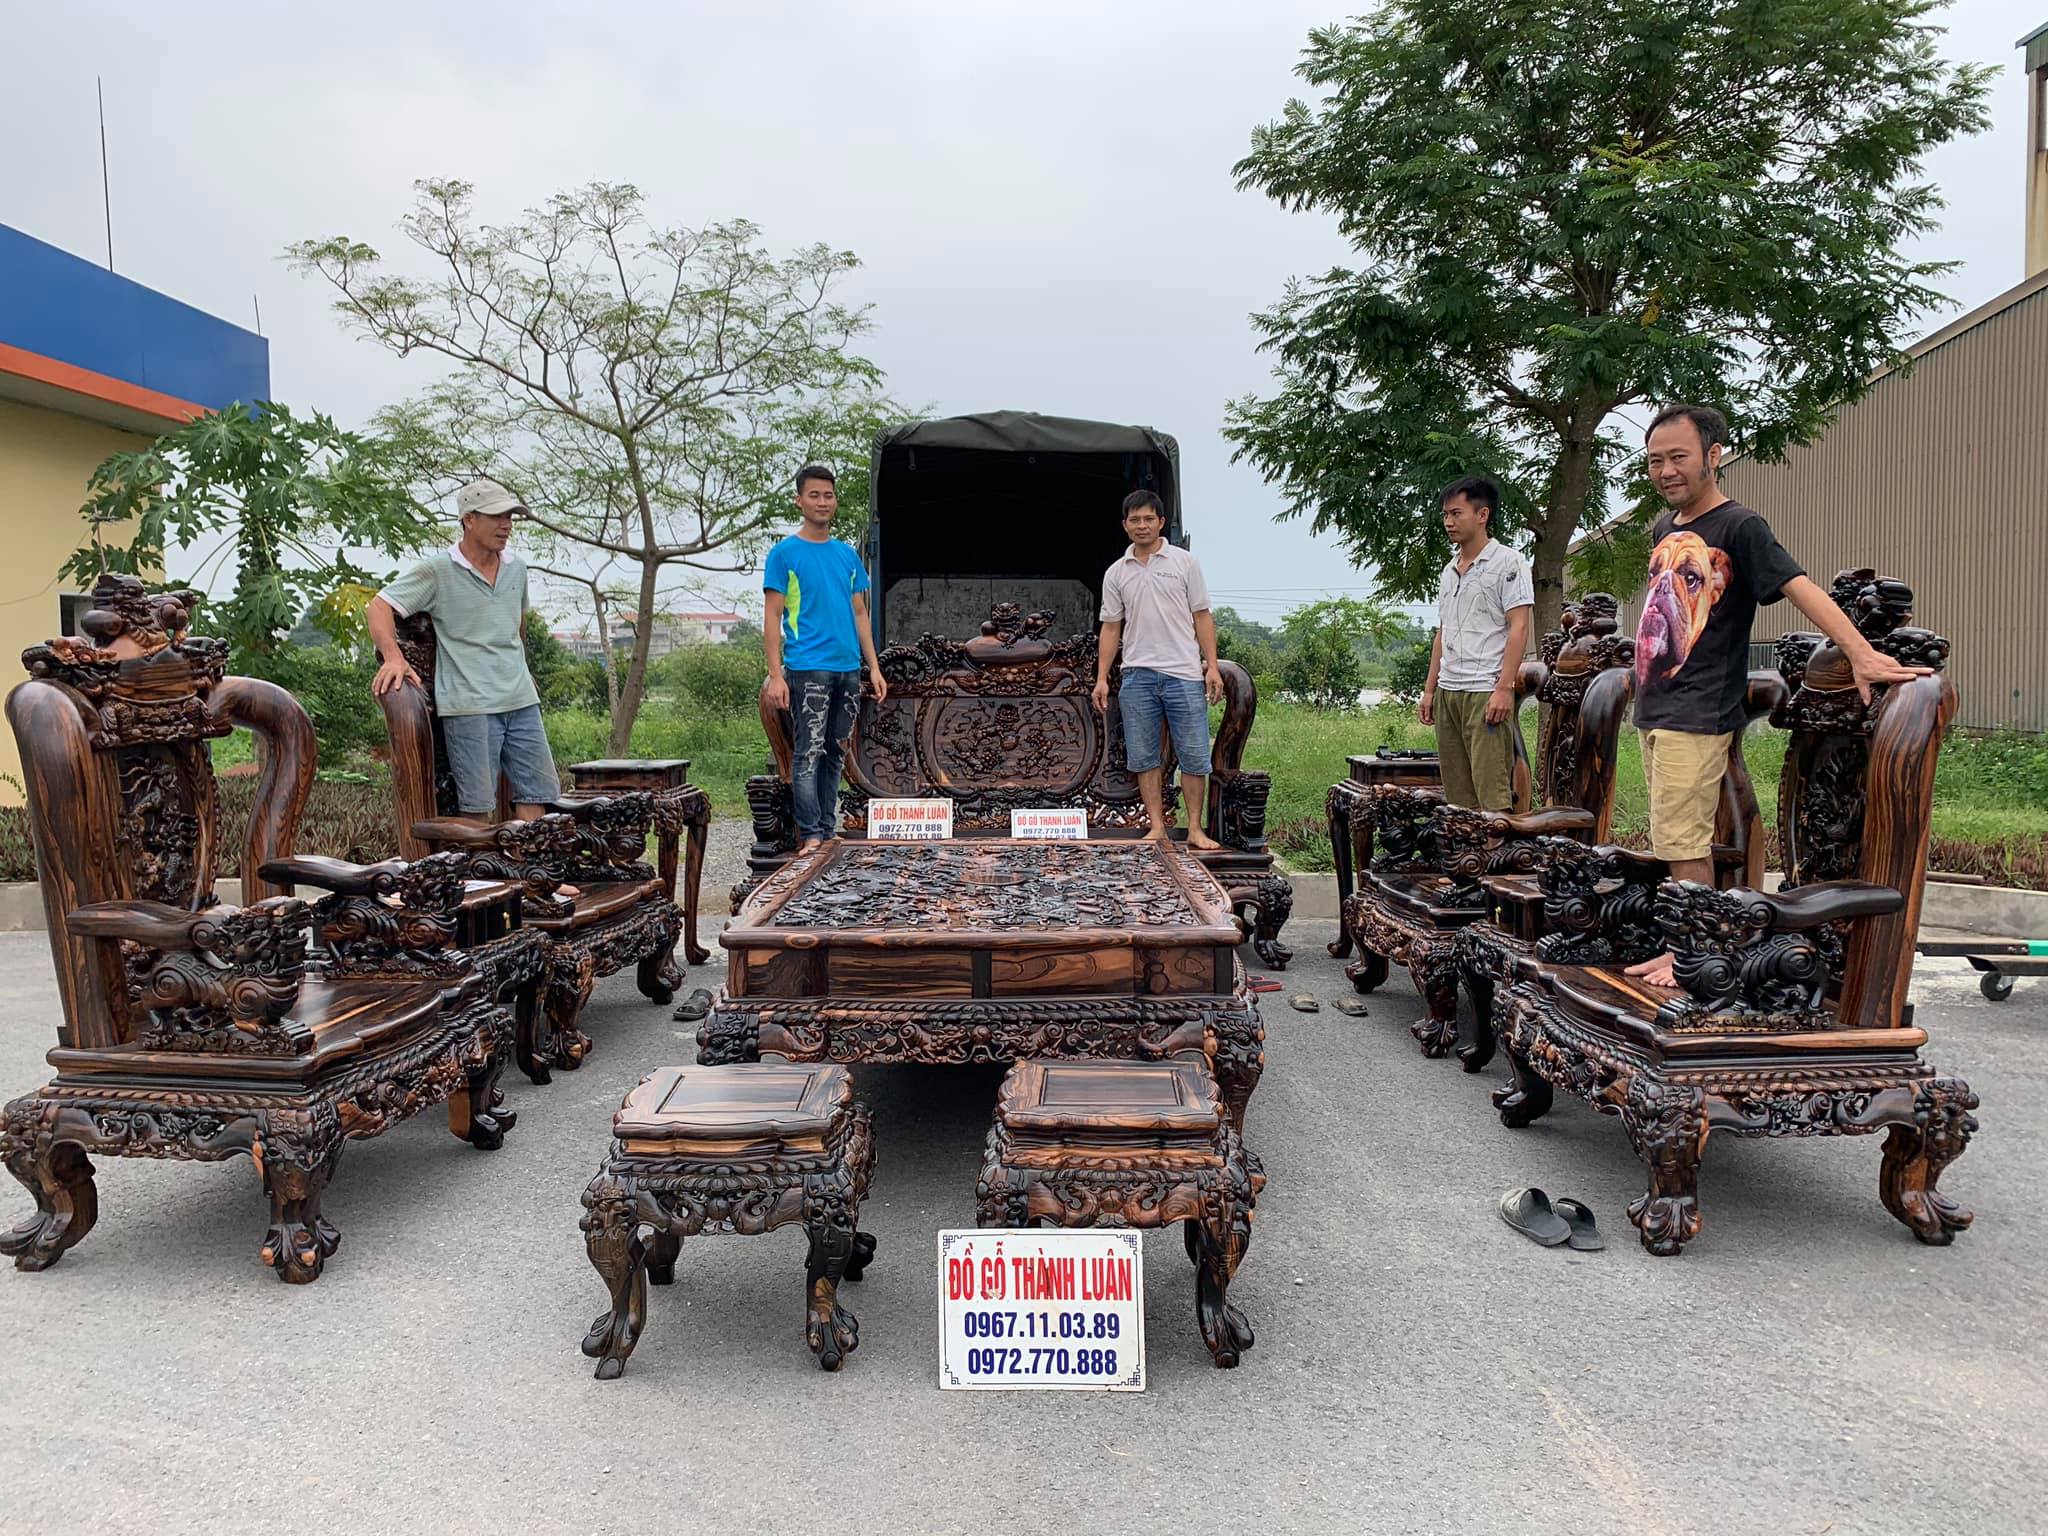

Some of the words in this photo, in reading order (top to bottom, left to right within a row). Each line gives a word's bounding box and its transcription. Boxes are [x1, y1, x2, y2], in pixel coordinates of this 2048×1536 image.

[948, 1242, 975, 1301] ĐỒ
[980, 1241, 1007, 1301] GỖ
[1012, 1248, 1075, 1301] THÀNH
[1081, 1248, 1132, 1301] LUÂN
[964, 1311, 1120, 1339] 0967.11.03.89
[968, 1348, 1118, 1375] 0972.770.888
